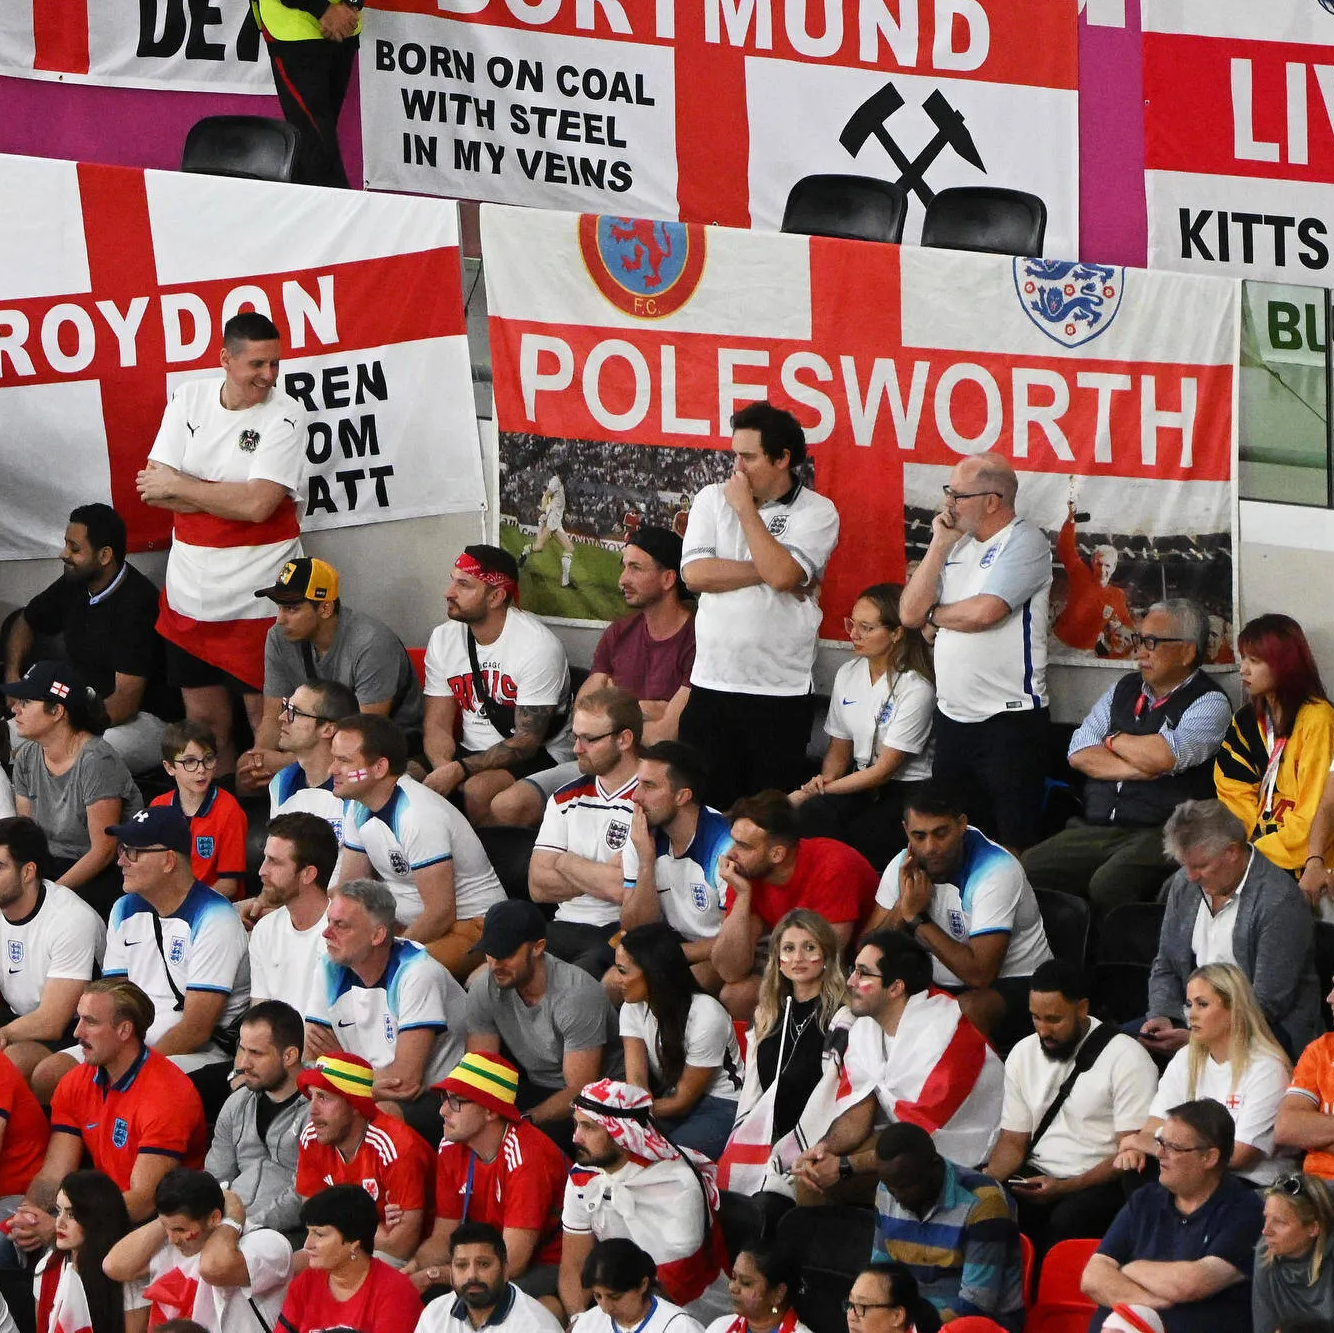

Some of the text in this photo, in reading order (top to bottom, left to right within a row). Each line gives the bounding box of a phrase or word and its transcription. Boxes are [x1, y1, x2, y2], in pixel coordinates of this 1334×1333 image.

[375, 39, 656, 107] BORN ON COAL
[400, 88, 628, 149] WITH STEEL
[402, 133, 634, 193] IN MY VEINS
[1178, 206, 1330, 270] KITTS
[633, 296, 663, 315] F.C.
[287, 360, 389, 413] REN
[518, 331, 1198, 468] POLESWORTH
[306, 414, 381, 465] OM
[306, 464, 395, 517] ATT
